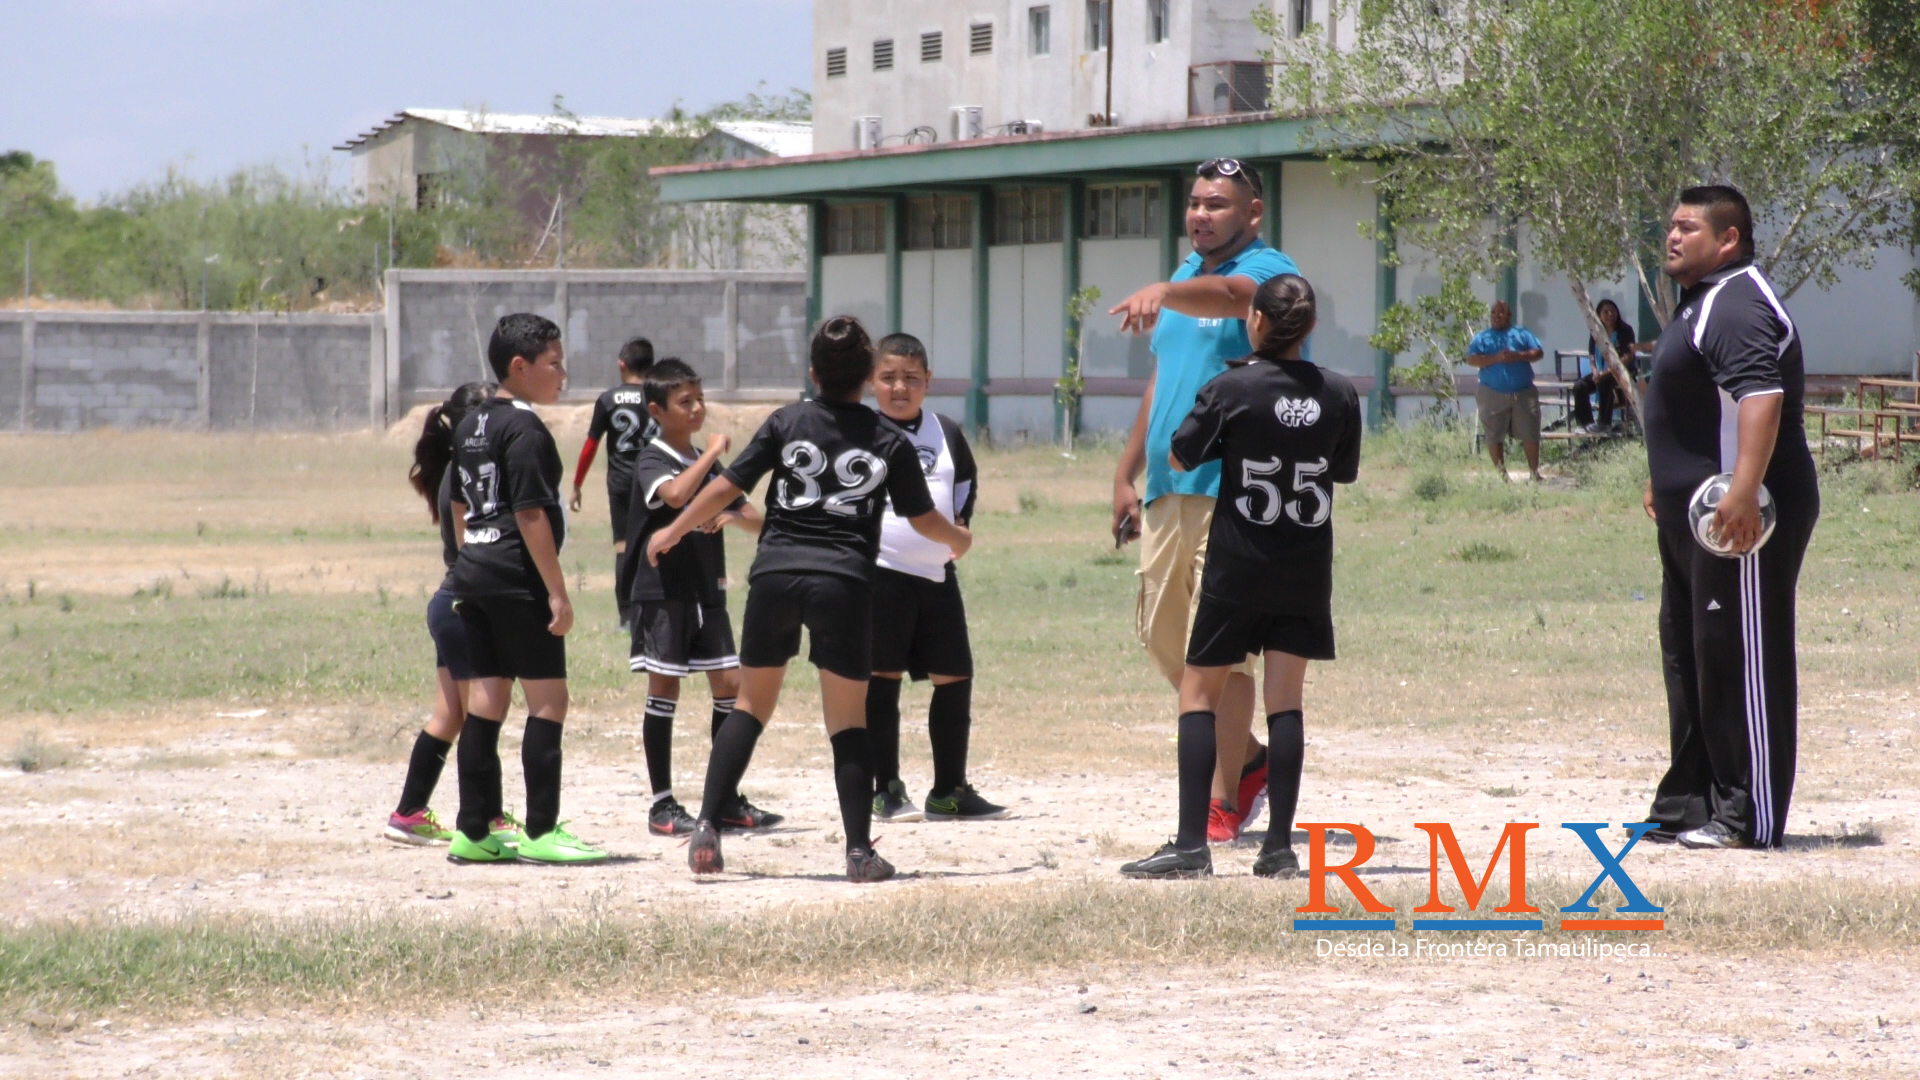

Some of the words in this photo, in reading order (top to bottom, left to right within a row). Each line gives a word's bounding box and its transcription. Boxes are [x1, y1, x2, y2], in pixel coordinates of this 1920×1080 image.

[614, 391, 642, 405] CHRIS
[1280, 409, 1317, 427] GFC
[777, 440, 888, 518] 32
[1235, 456, 1331, 528] 55
